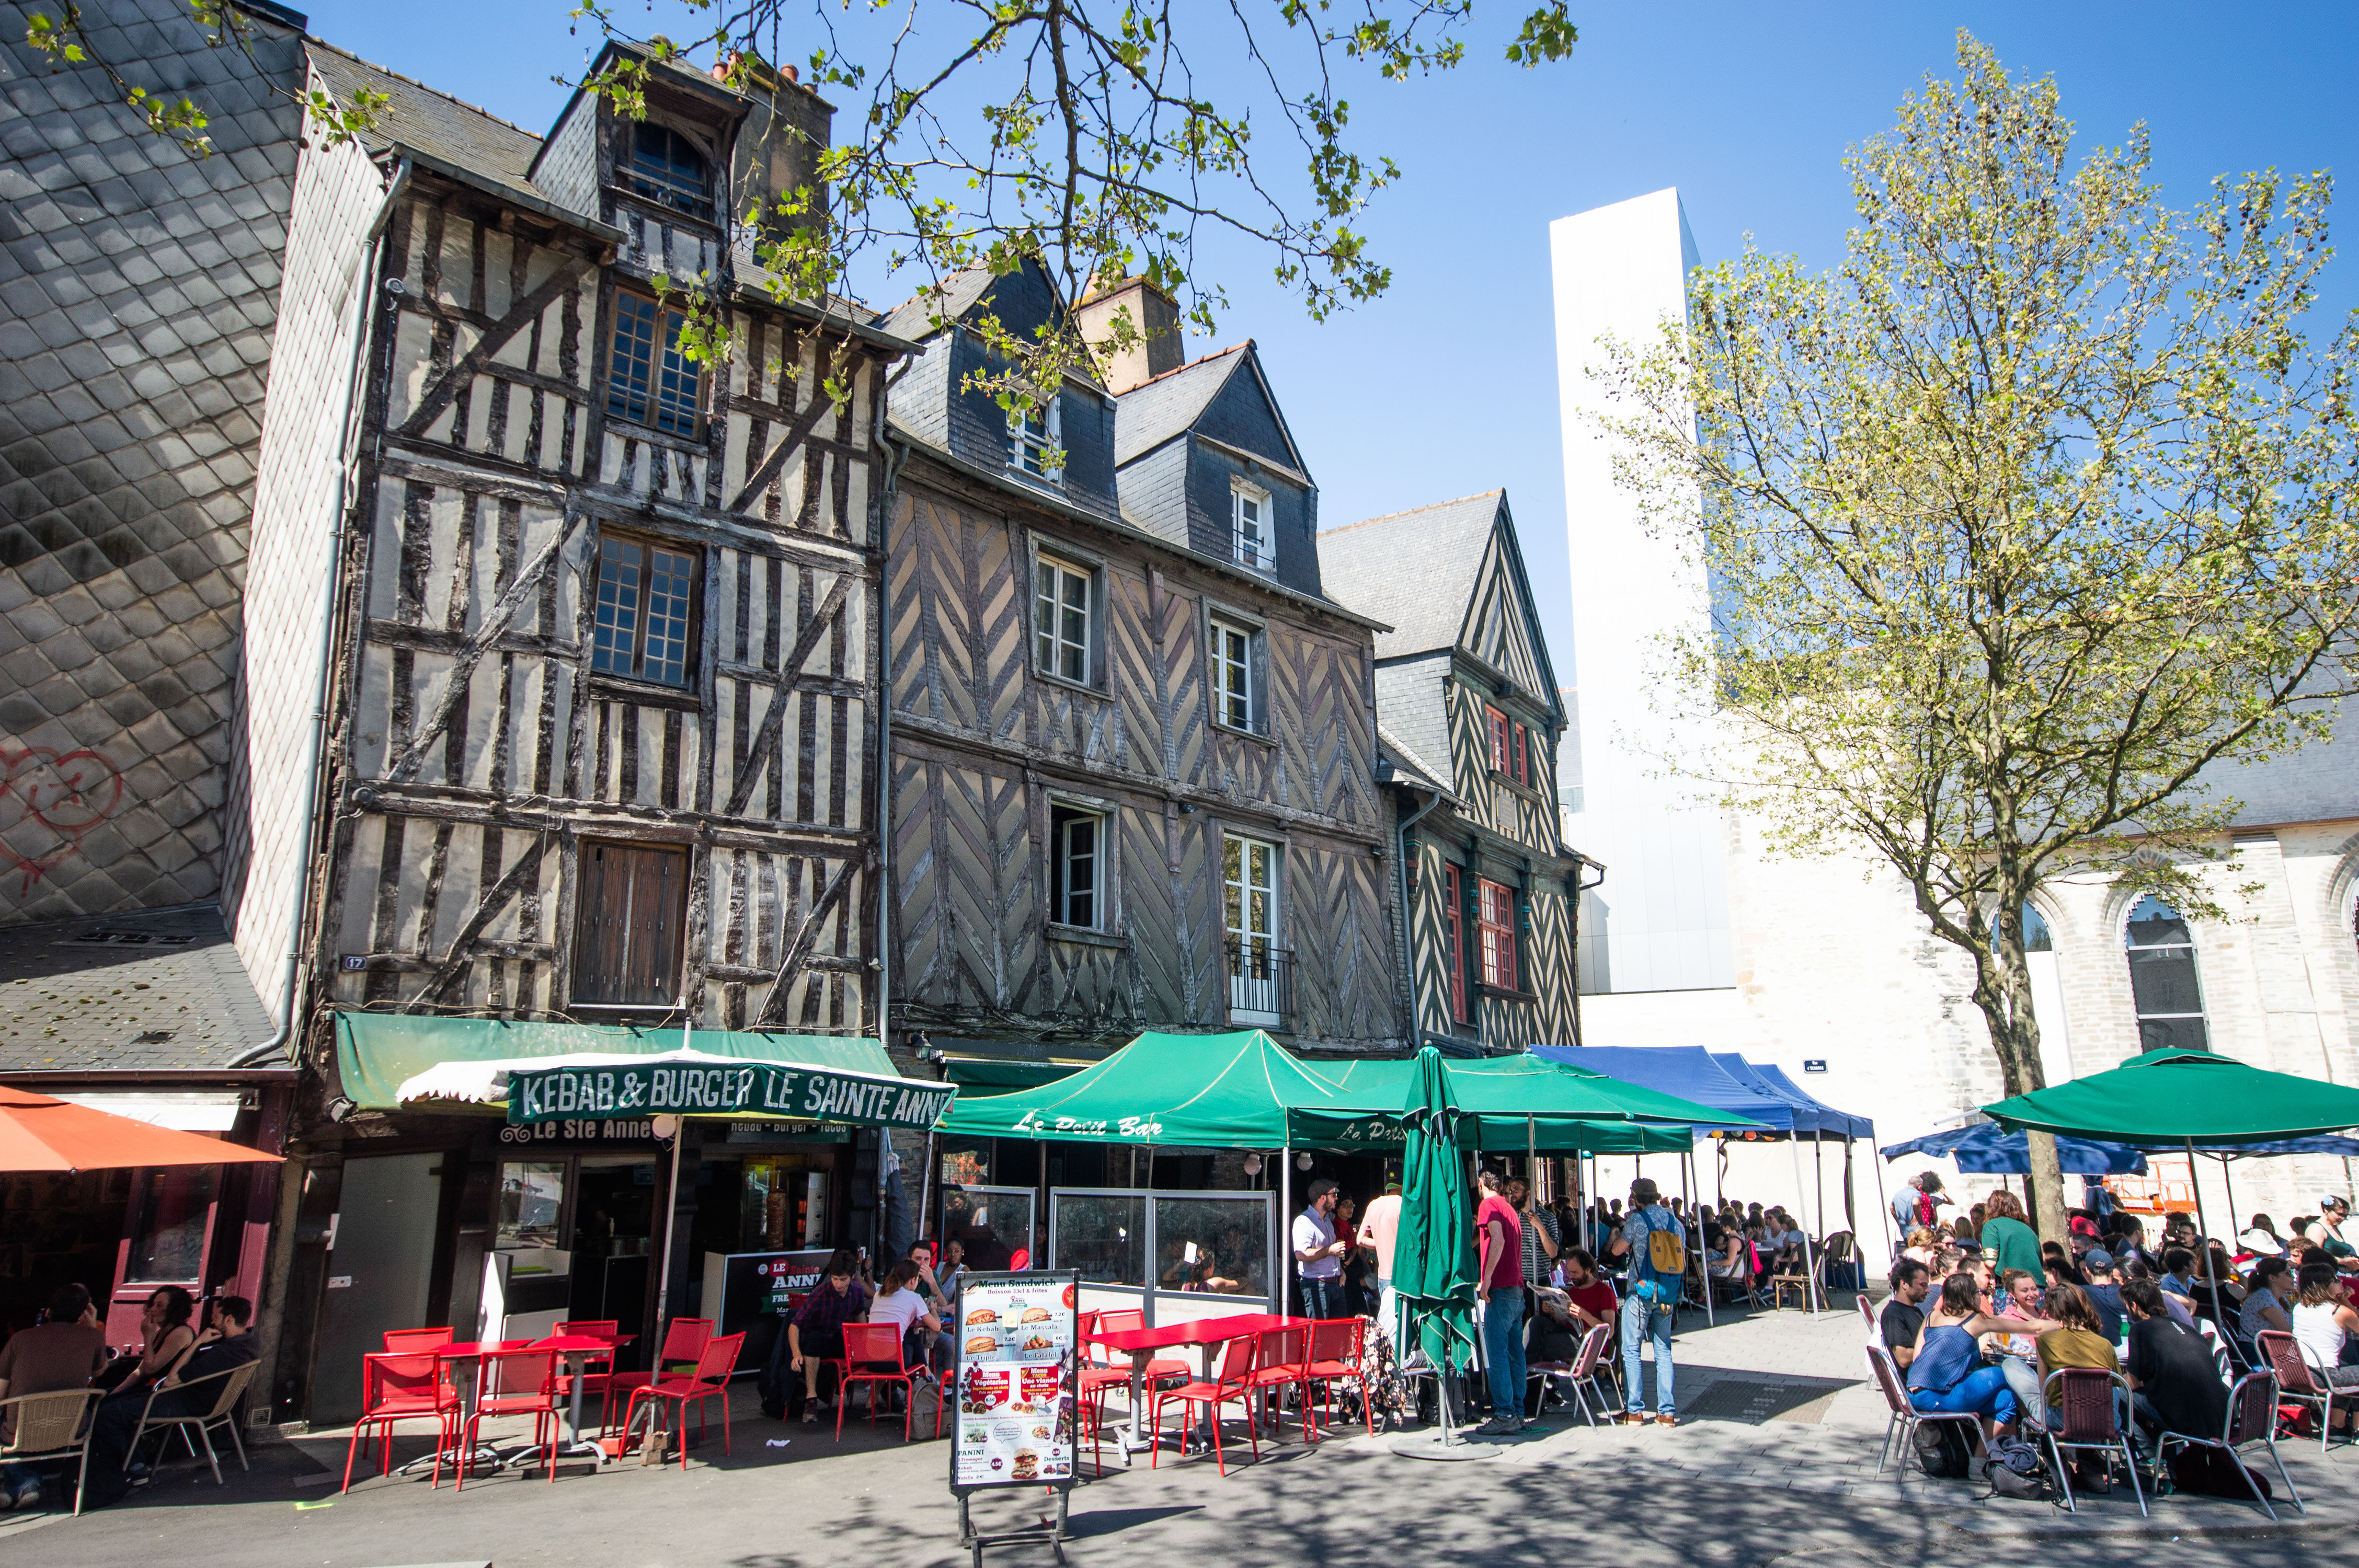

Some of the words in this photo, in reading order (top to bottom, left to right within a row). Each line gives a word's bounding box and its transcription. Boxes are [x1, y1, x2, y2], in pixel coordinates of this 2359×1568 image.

[350, 959, 362, 967] 17
[523, 1073, 615, 1115] KEBAB
[619, 1073, 647, 1108] &
[650, 1069, 754, 1107] BURGER
[764, 1071, 798, 1109] LE
[804, 1076, 896, 1120] SAINTE
[534, 1121, 556, 1138] Le
[564, 1119, 596, 1138] Ste
[603, 1119, 650, 1138] Anne
[1012, 1112, 1044, 1131] Le
[1056, 1117, 1107, 1135] Petit
[1118, 1116, 1163, 1136] Bar
[1337, 1123, 1360, 1140] Le
[773, 1263, 786, 1272] LE
[789, 1265, 820, 1274] Sainte
[1009, 1278, 1056, 1287] Sandwich
